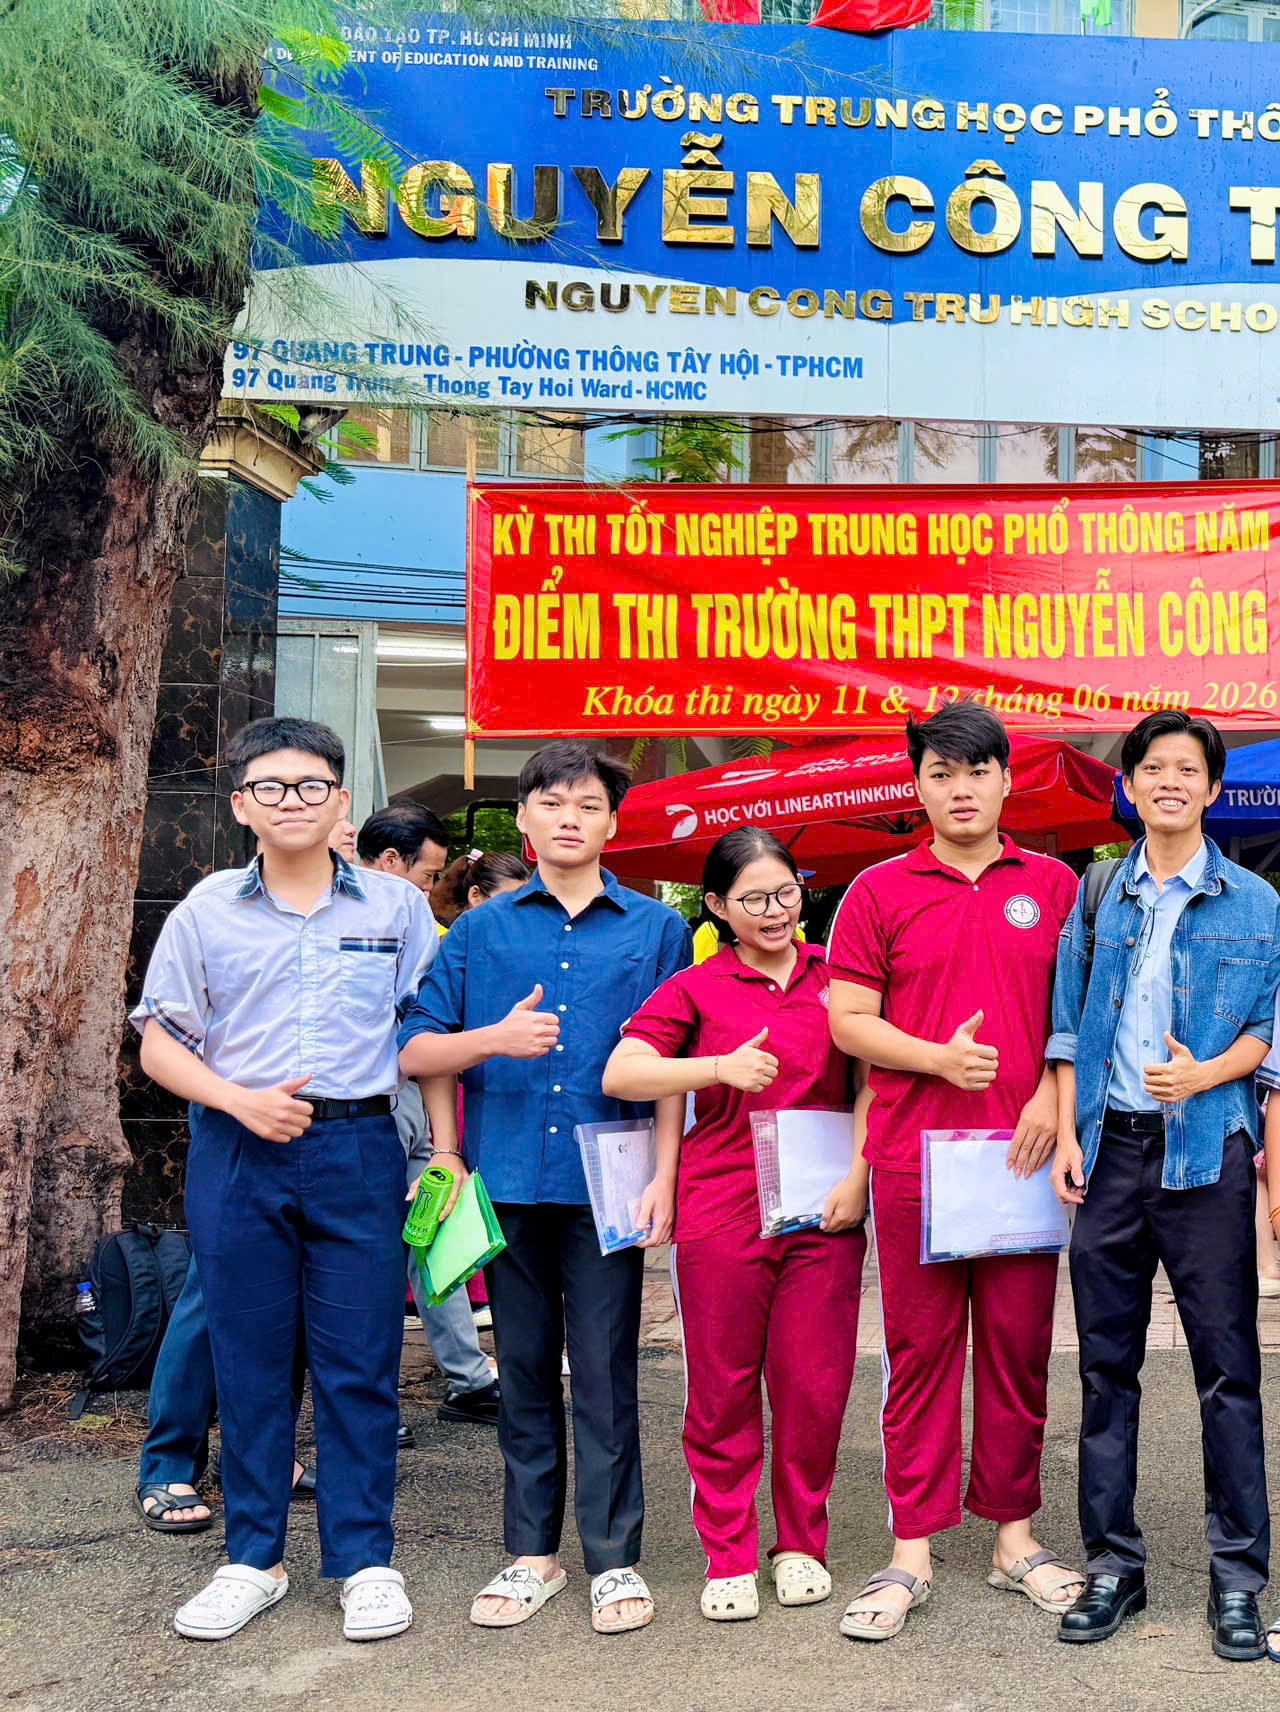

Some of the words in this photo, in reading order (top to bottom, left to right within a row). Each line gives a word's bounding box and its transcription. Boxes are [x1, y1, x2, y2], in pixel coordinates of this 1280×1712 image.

[381, 51, 402, 65] OF
[404, 51, 490, 68] EDUCATION
[493, 55, 524, 69] AND
[526, 55, 599, 71] TRAINING
[524, 32, 572, 50] MINH
[545, 75, 760, 124] TRƯỜNG
[771, 93, 947, 130] TRUNG
[956, 101, 1064, 144] HỌC
[1073, 87, 1179, 138] PHỔ
[312, 131, 821, 250] NGUYỄN
[859, 159, 1190, 263] CÔNG
[524, 279, 738, 316] NGUYEN
[747, 286, 893, 320] CONG
[904, 291, 1001, 324] TRU
[1010, 294, 1131, 328] HIGH
[232, 339, 264, 361] 97
[272, 338, 358, 366] QUANG
[364, 343, 450, 367] TRUNG
[469, 338, 570, 371] PHƯỜNG
[576, 344, 660, 373] THÔNG
[666, 346, 712, 374] TÂY
[720, 348, 760, 380] HỘI
[776, 354, 864, 379] TPHCM
[231, 368, 261, 388] 97
[267, 367, 337, 393] Quang
[423, 373, 491, 398] Thong
[498, 376, 534, 400] Tay
[539, 377, 574, 397] Hoi
[581, 378, 633, 399] Ward
[646, 380, 708, 400] HCMC
[492, 505, 536, 556] KỲ
[544, 513, 598, 556] THI
[607, 499, 666, 556] TỐT
[675, 504, 798, 566] NGHIỆP
[807, 513, 919, 556] TRUNG
[927, 513, 994, 565] HỌC
[1004, 495, 1071, 555] PHỔ
[1079, 503, 1185, 555] THÔNG
[1194, 502, 1270, 552] NĂM
[493, 564, 600, 661] ĐIỂM
[613, 592, 679, 660] THI
[691, 576, 858, 661] TRƯỜNG
[869, 592, 970, 660] THPT
[983, 567, 1147, 660] NGUYỄN
[1158, 576, 1269, 658] CÔNG
[581, 685, 675, 716] Khóa
[685, 684, 734, 716] thi
[742, 684, 821, 723] ngày
[832, 684, 868, 715] 11
[880, 684, 912, 715] &
[1073, 682, 1112, 713] 06
[1121, 682, 1191, 712] năm
[1202, 679, 1279, 710] 2026
[703, 806, 741, 827] HỌC
[744, 799, 774, 819] VỚI
[775, 783, 915, 816] LINEARTHINKING
